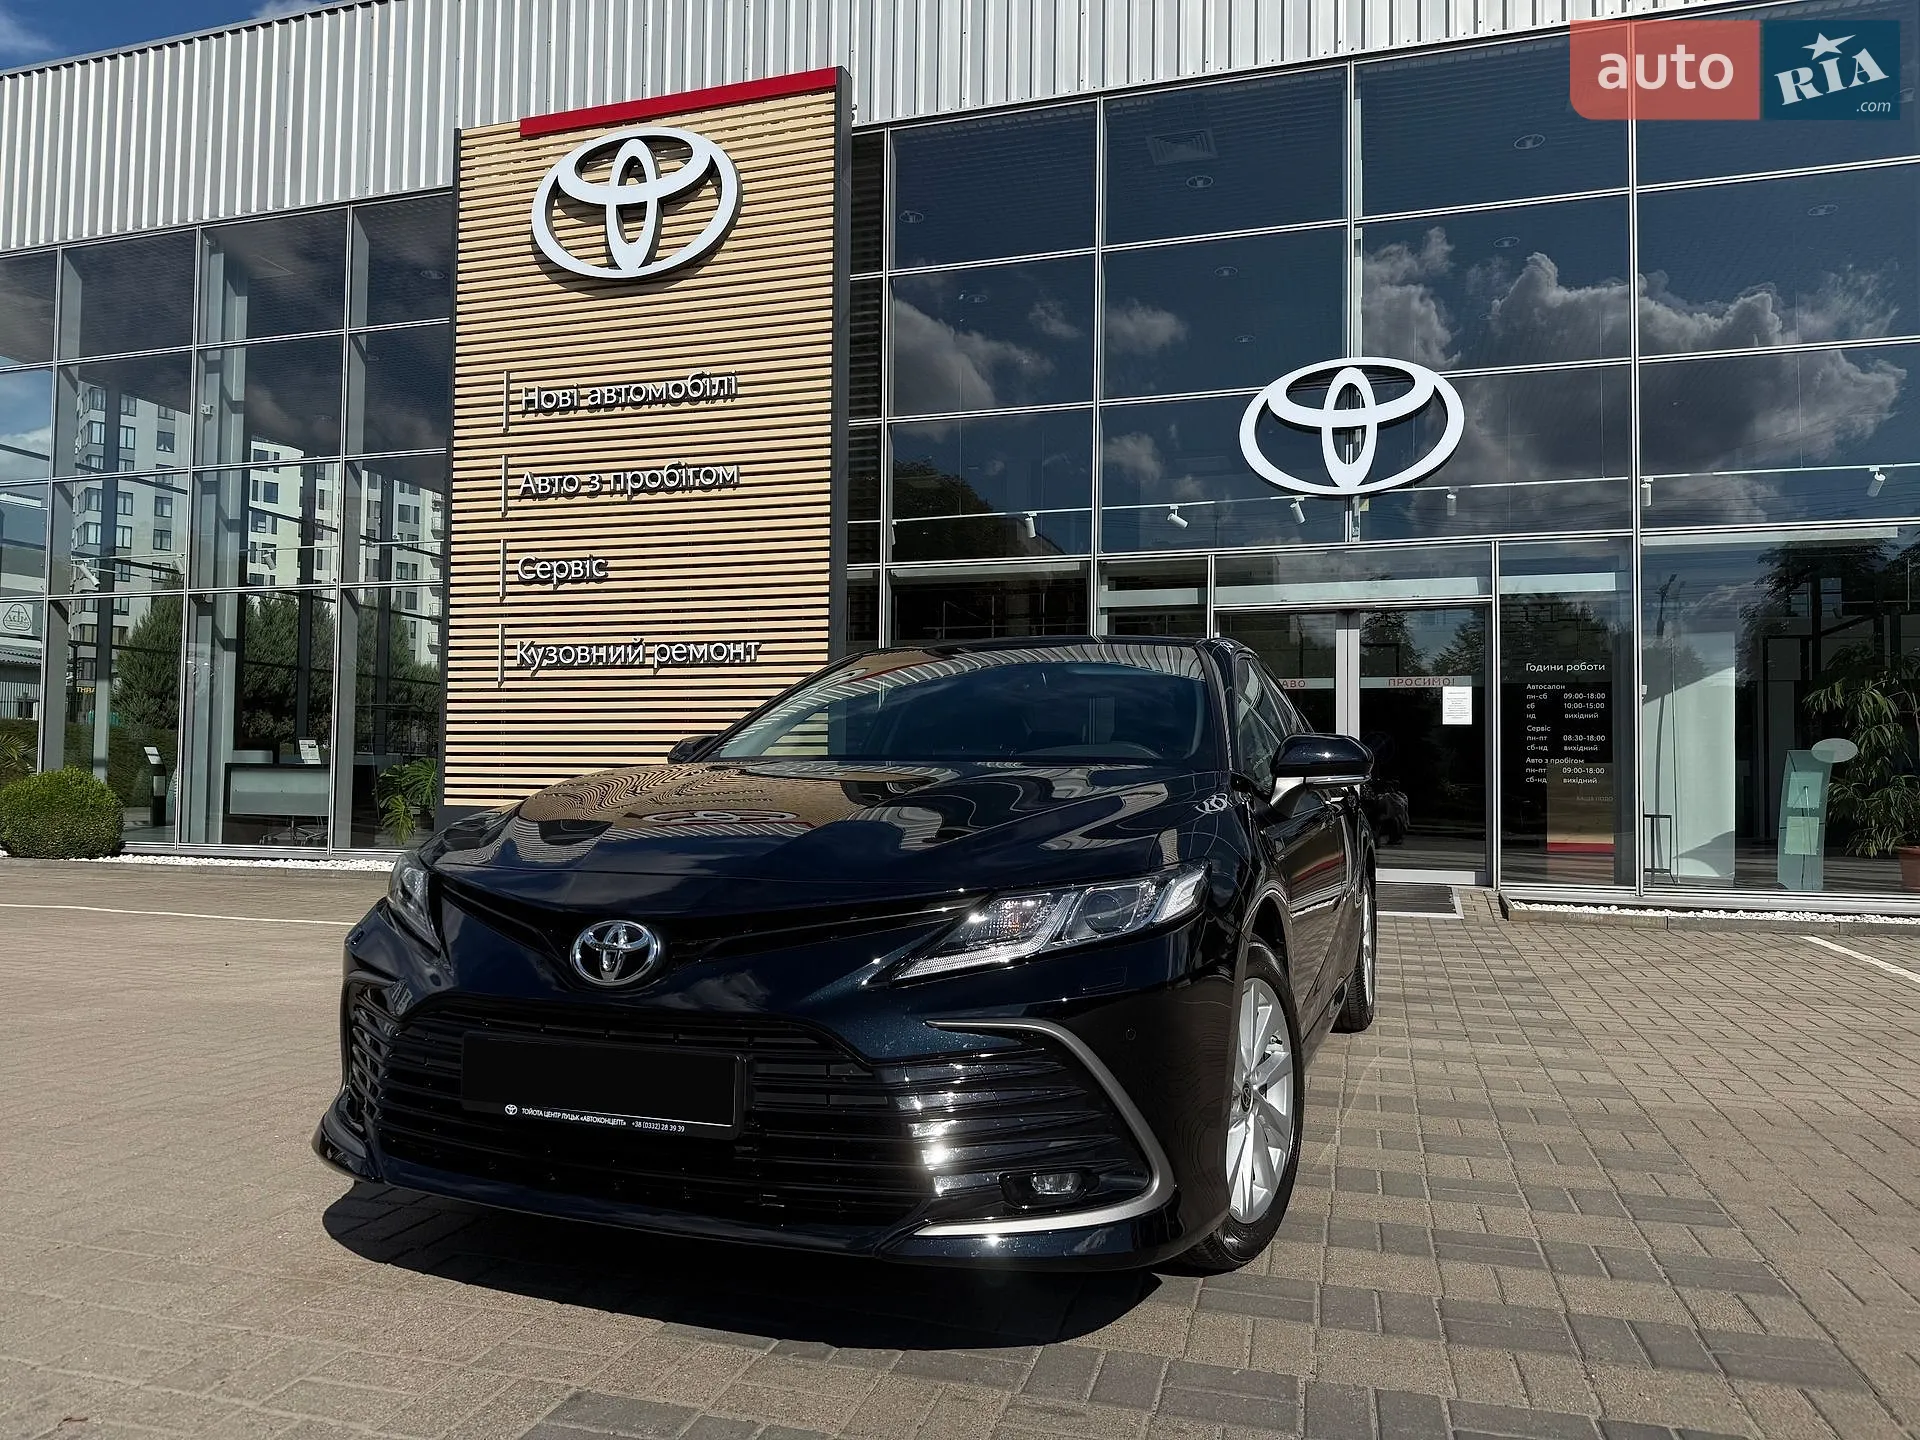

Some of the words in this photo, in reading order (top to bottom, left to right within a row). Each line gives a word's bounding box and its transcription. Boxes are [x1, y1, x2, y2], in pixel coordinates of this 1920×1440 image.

[521, 383, 580, 411] Нові
[587, 370, 739, 406] автомобілі
[518, 471, 581, 496] Авто
[588, 471, 602, 492] з
[609, 460, 740, 496] пробігом
[517, 554, 609, 584] Сервіс
[515, 637, 646, 671] Кузовний
[652, 640, 762, 670] ремонт
[1525, 662, 1564, 673] Години
[1566, 661, 1606, 673] роботи
[1282, 679, 1306, 688] АВО
[1388, 677, 1455, 687] ПРОСИМО!
[1563, 692, 1606, 700] 09:00-18:00
[1564, 712, 1599, 720] вихідний
[1526, 724, 1551, 732] Сервіс
[1563, 734, 1606, 742] 08:30-18:00
[1526, 743, 1549, 751] сб-нд
[1563, 744, 1599, 752] вихідний
[1550, 757, 1585, 765] пробігом
[1525, 775, 1548, 784] сб-нд
[1562, 776, 1598, 784] вихідний
[521, 1107, 544, 1117] ТОЙОТА
[543, 1110, 561, 1119] ЦЕНТР
[631, 1120, 642, 1128] +38
[642, 1121, 660, 1130] (0332)
[661, 1123, 669, 1131] 28
[669, 1124, 677, 1132] 39
[677, 1125, 685, 1133] 39
